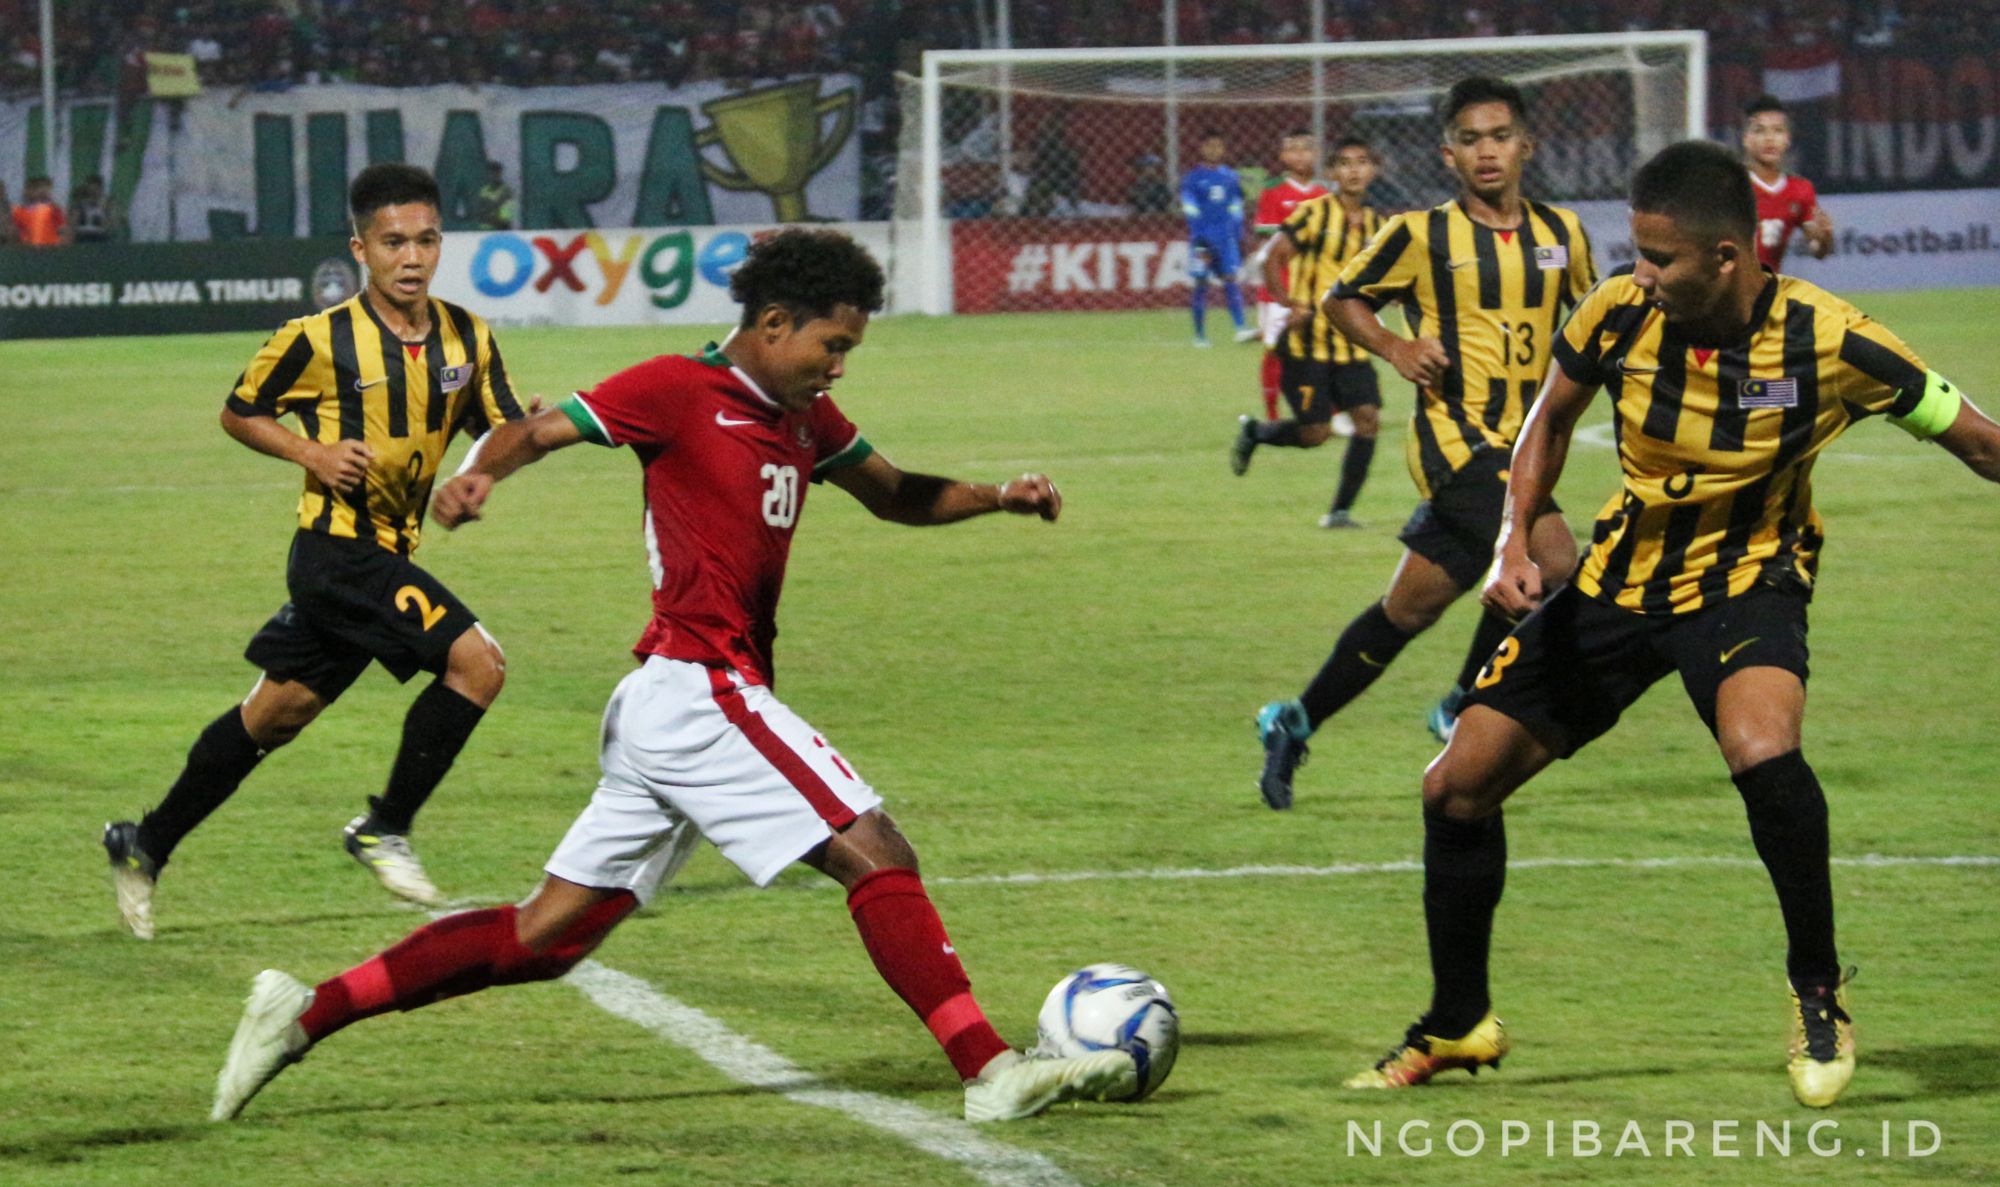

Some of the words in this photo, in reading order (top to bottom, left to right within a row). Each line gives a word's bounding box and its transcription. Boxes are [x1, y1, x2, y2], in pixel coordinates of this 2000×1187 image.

[118, 280, 201, 305] JAWA
[206, 277, 302, 302] TIMUR
[470, 230, 783, 309] oxyge
[1006, 240, 1264, 294] #KITA
[1502, 321, 1534, 367] 13
[1298, 385, 1315, 411] 7
[760, 463, 799, 528] 20
[394, 585, 448, 632] 2
[1474, 636, 1521, 690] 3
